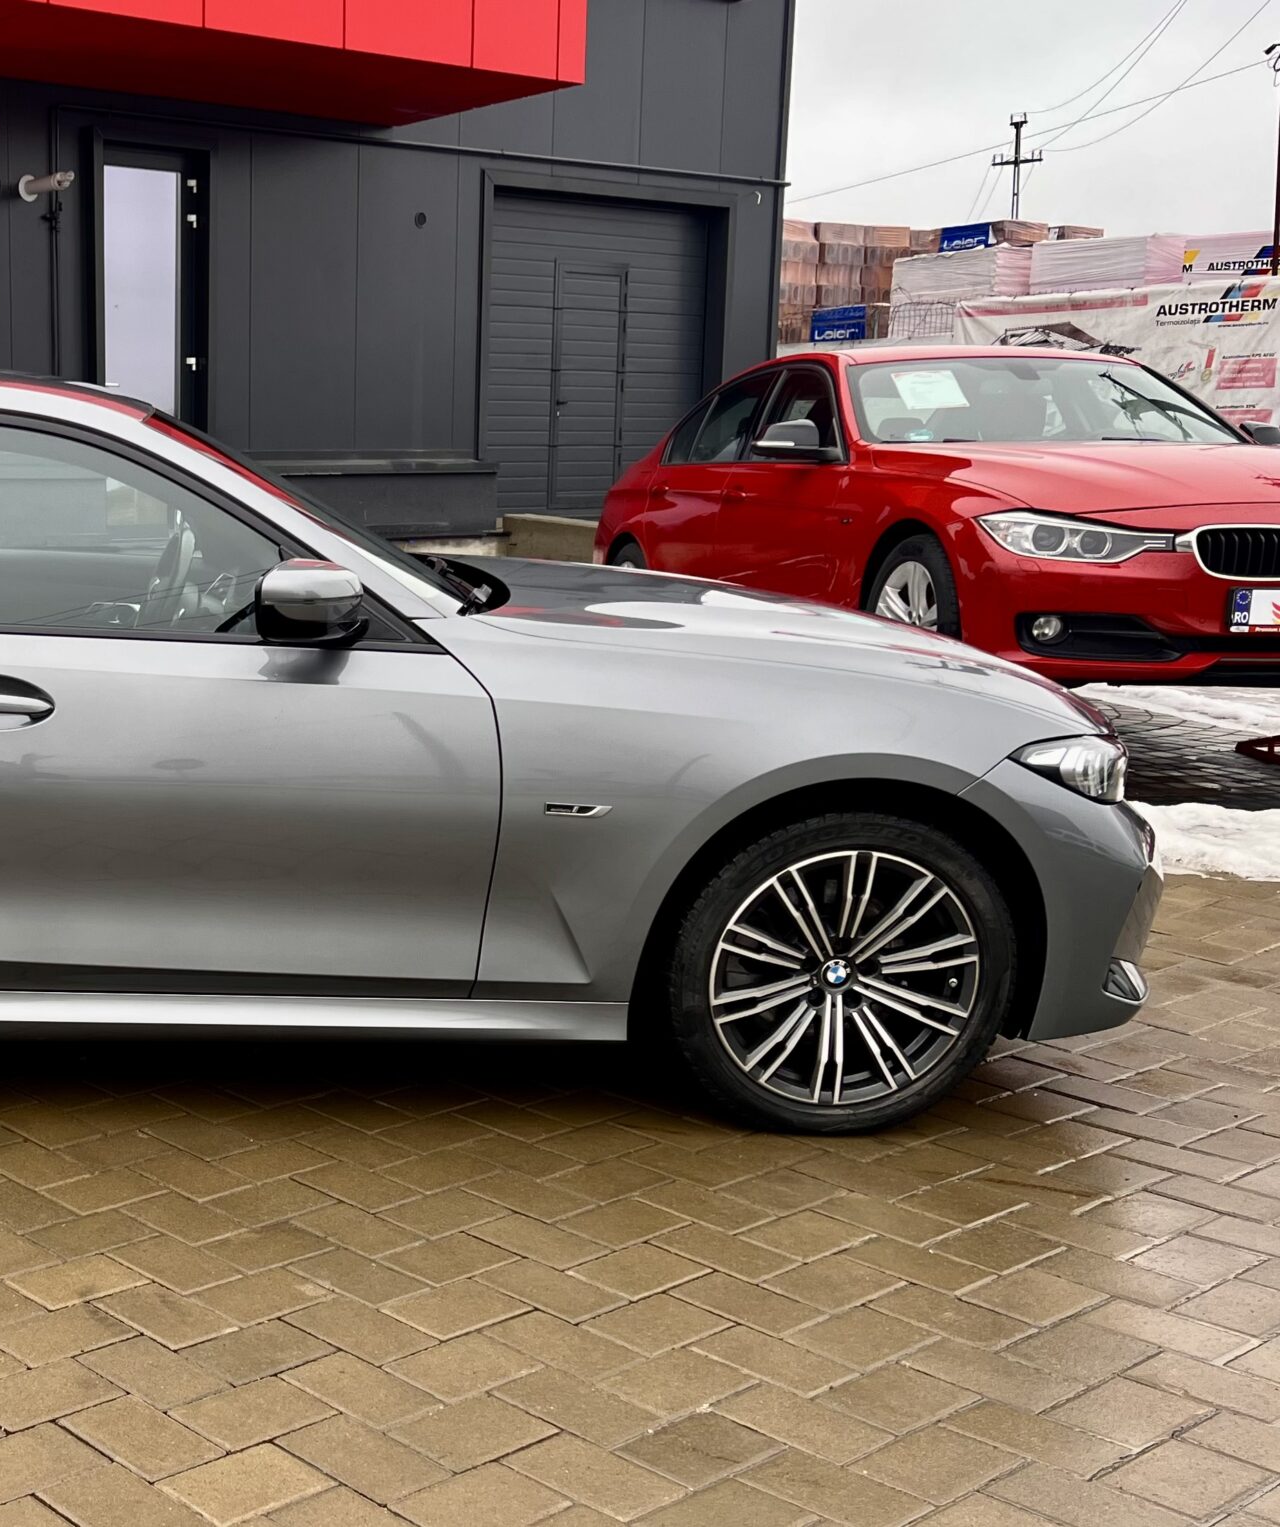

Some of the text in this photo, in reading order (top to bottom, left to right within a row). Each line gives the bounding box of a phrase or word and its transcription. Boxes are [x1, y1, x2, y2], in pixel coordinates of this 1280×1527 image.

[1207, 260, 1280, 271] AUSTROTH
[1156, 299, 1278, 317] AUSTROTHERM
[1234, 611, 1249, 623] RO
